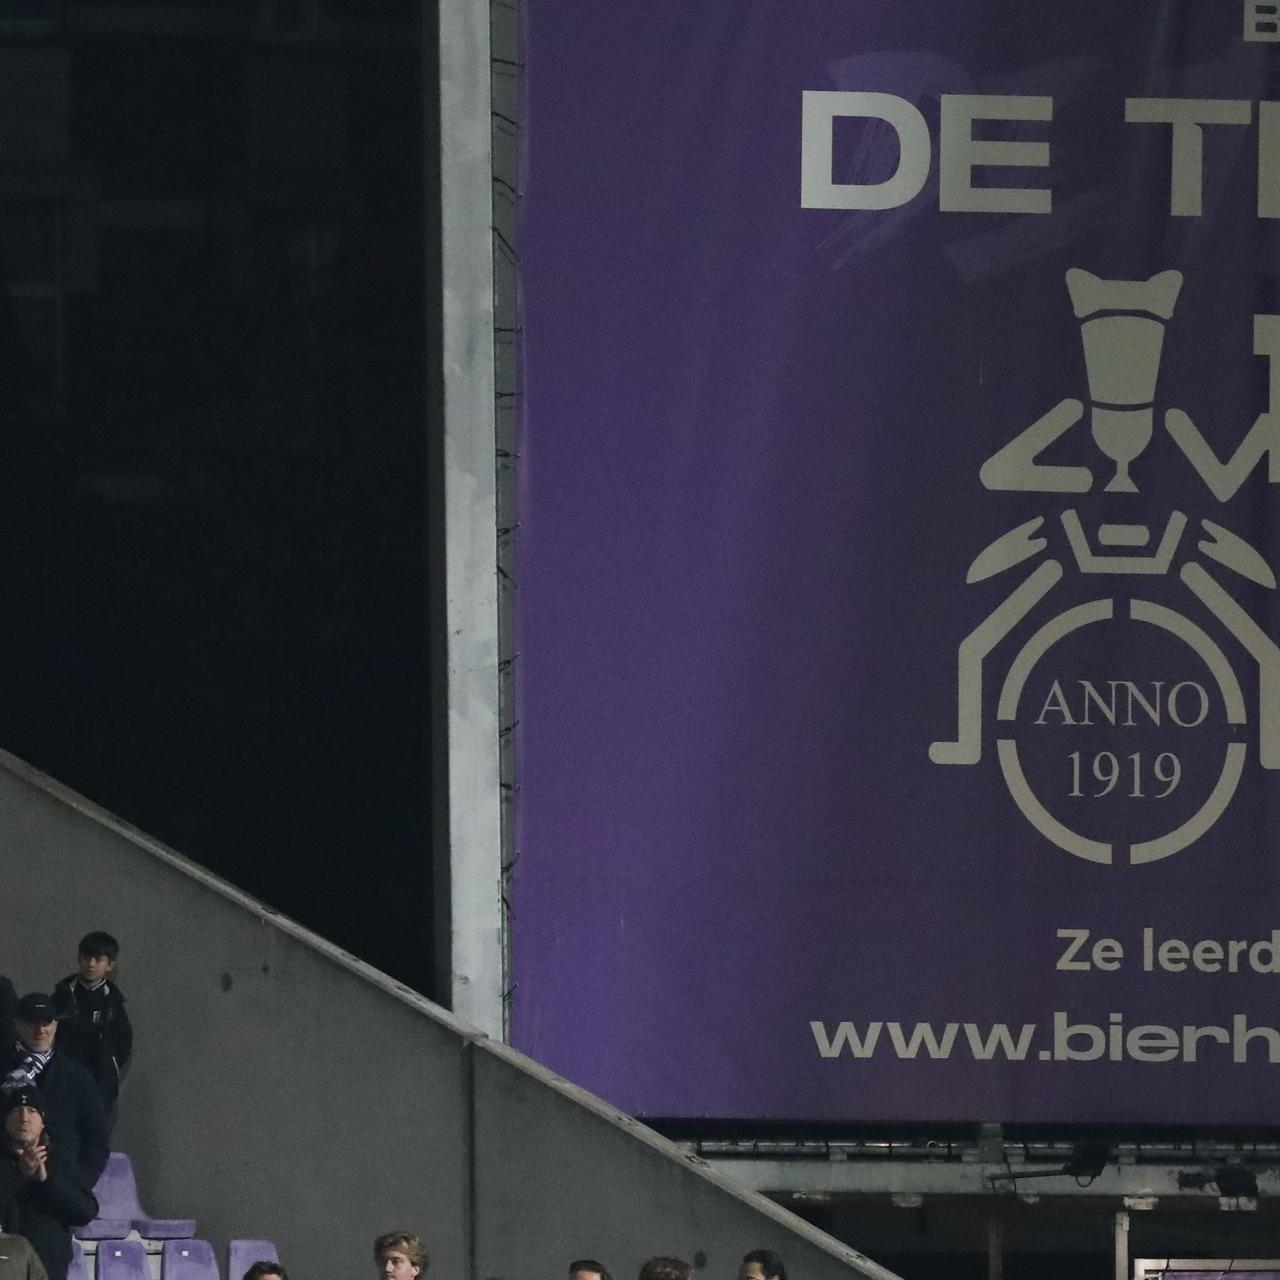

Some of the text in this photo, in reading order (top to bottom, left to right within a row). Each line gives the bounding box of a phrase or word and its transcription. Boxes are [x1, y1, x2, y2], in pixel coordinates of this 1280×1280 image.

[800, 90, 1054, 214] DE
[1034, 679, 1210, 728] ANNO
[1068, 751, 1182, 799] 1919
[1055, 928, 1124, 972] Ze
